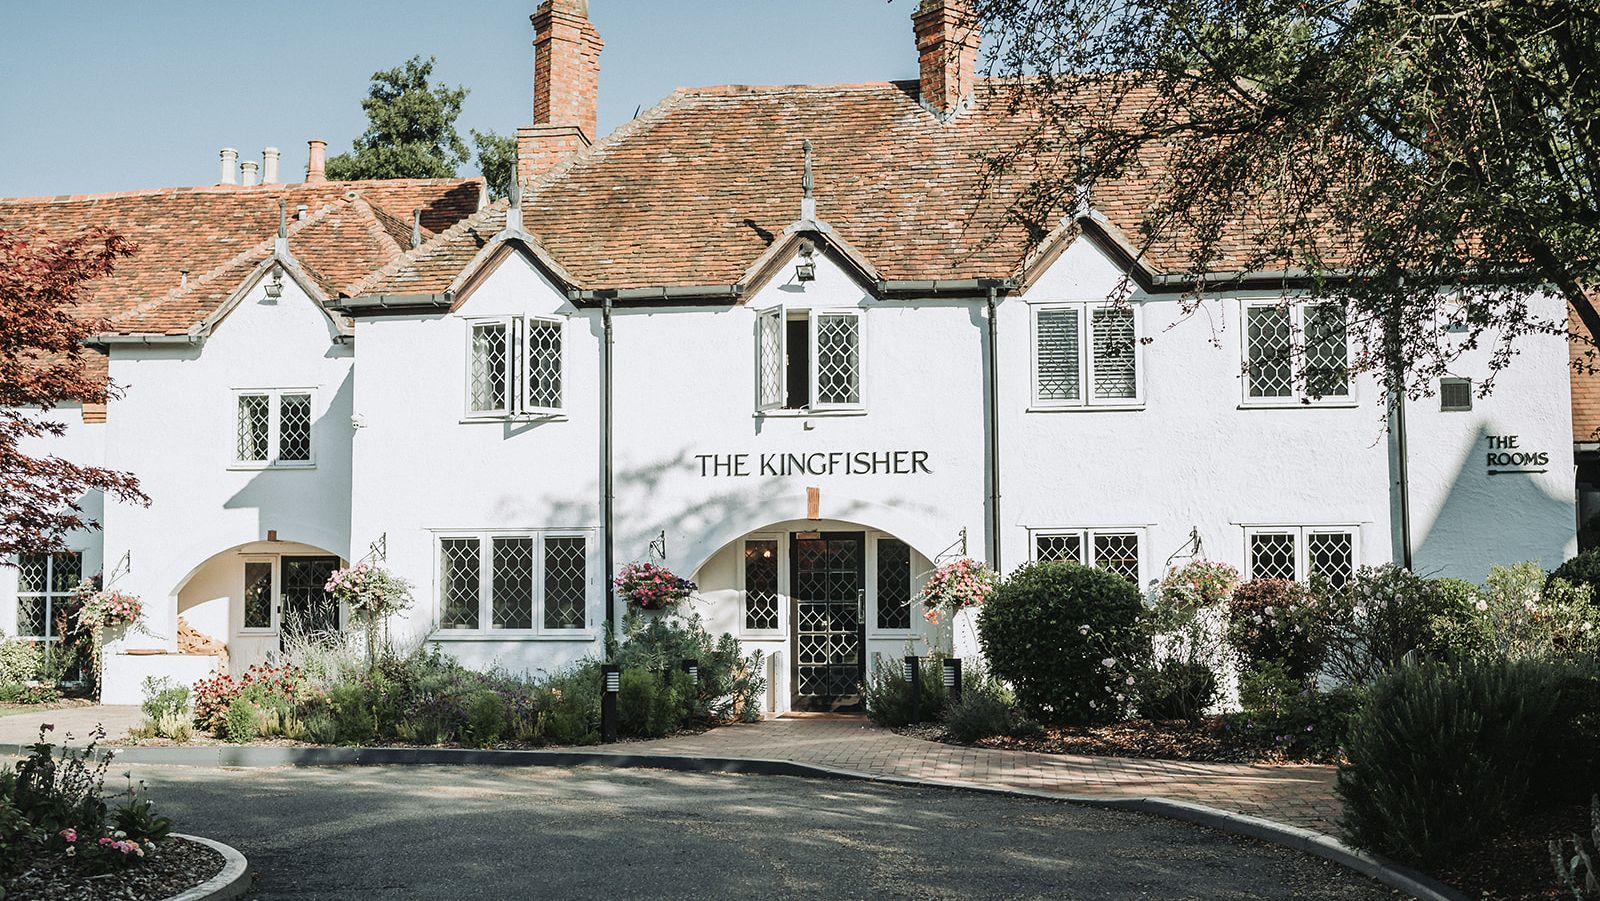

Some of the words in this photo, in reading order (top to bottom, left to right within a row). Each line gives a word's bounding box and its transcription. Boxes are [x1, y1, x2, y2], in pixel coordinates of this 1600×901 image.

[1485, 435, 1520, 449] THE
[695, 453, 750, 477] THE
[760, 451, 935, 476] KINGFISHER
[1486, 452, 1549, 466] ROOMS
